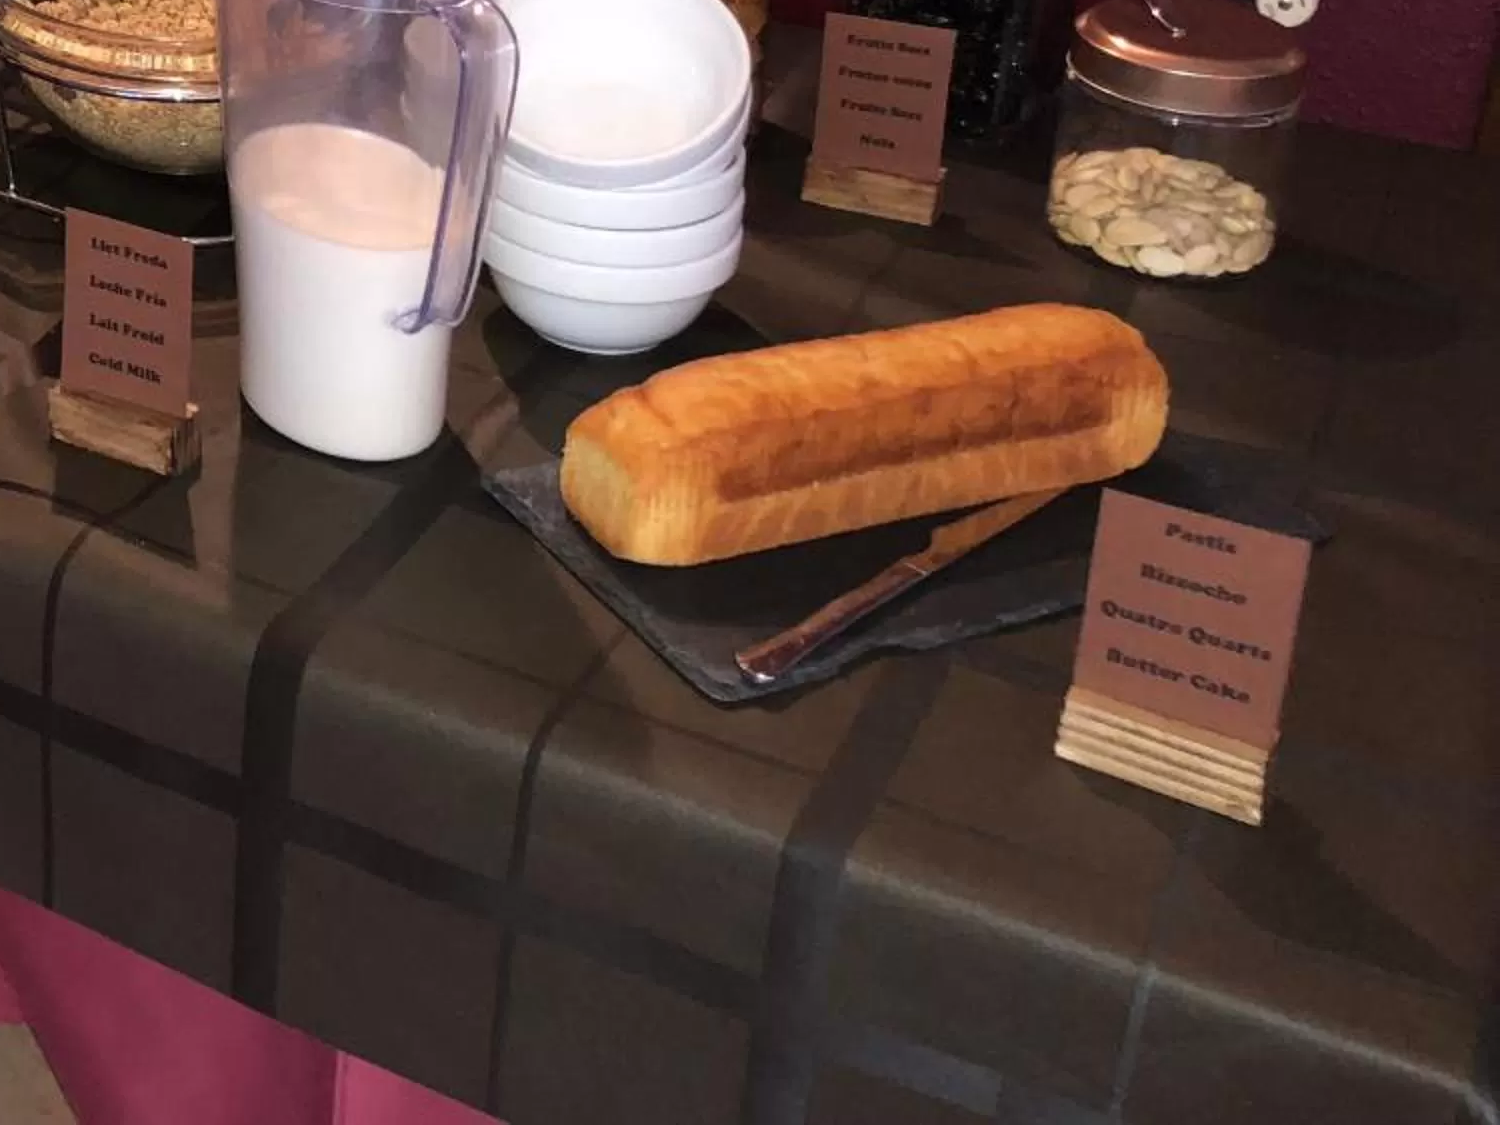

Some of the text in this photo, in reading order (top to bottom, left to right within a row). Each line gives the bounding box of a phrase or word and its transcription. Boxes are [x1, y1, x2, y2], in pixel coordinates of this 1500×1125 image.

[90, 236, 120, 256] Llet
[89, 274, 132, 297] Leche
[89, 312, 165, 346] Lait Froid
[88, 352, 162, 385] Cold Milk
[1187, 626, 1272, 661] Quarts
[1106, 646, 1251, 704] Butter Cake
